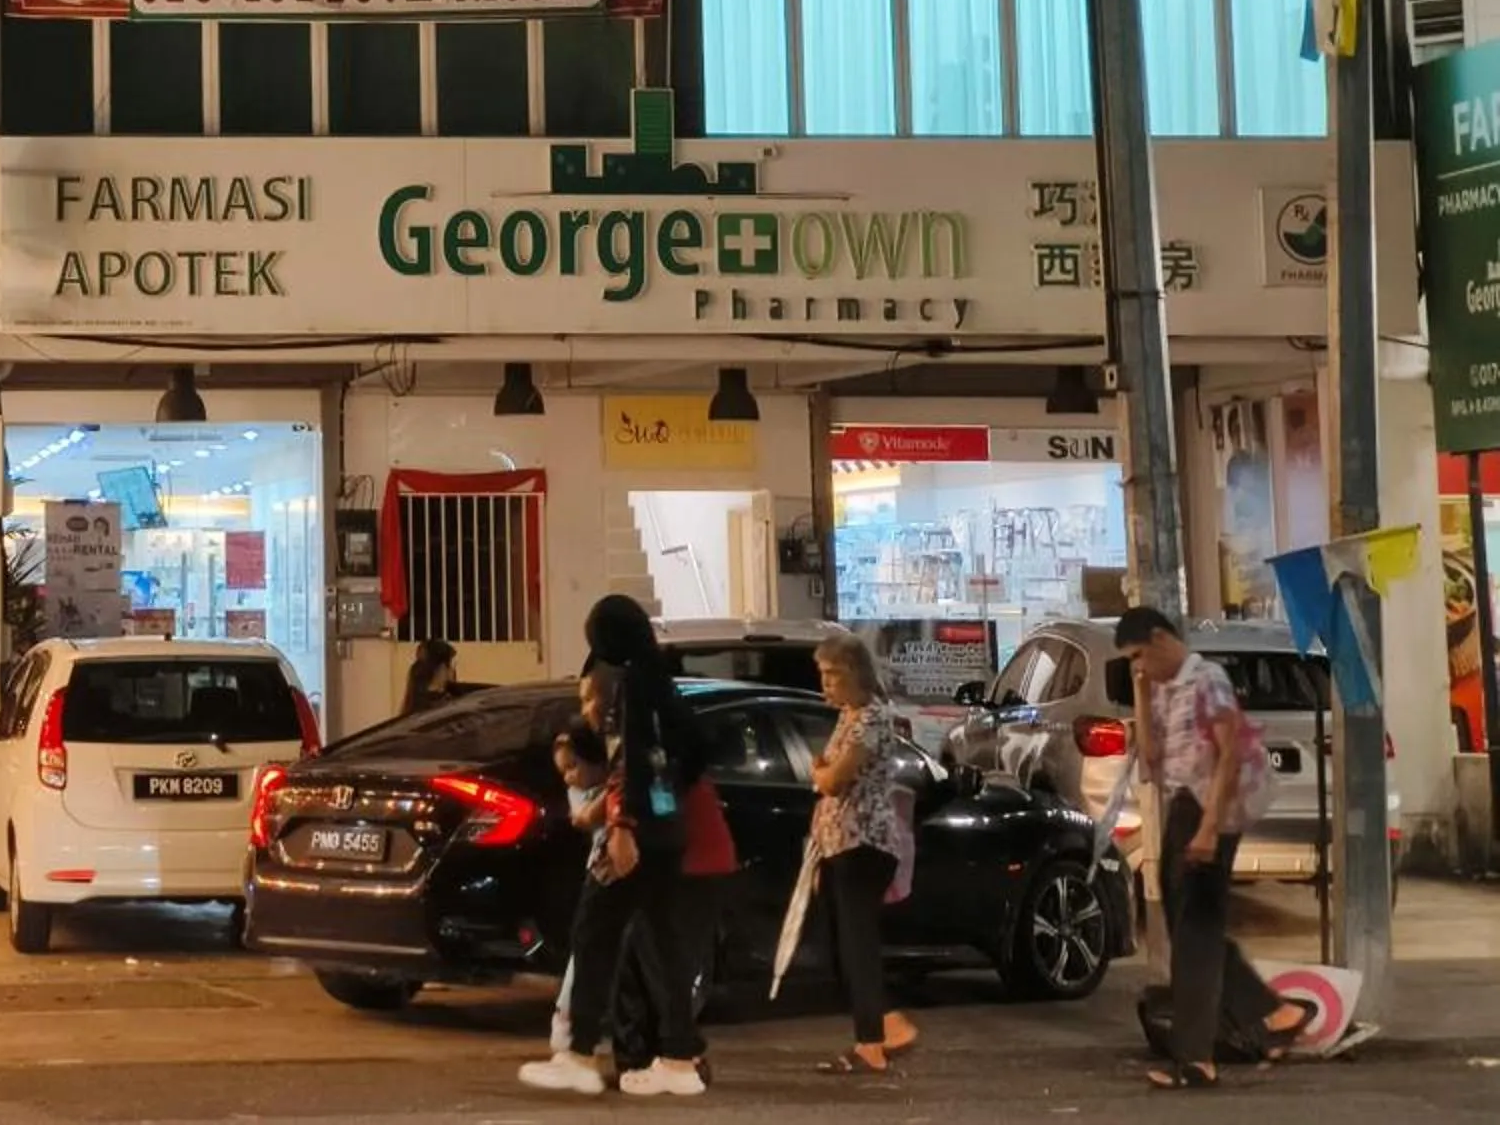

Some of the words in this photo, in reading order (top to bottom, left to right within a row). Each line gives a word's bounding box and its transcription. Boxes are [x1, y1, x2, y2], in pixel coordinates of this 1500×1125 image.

[54, 175, 311, 223] FARMASI
[1030, 180, 1099, 227] 巧
[54, 251, 283, 297] APOTEK
[695, 290, 970, 328] Pharmacy
[183, 777, 223, 795] 8209
